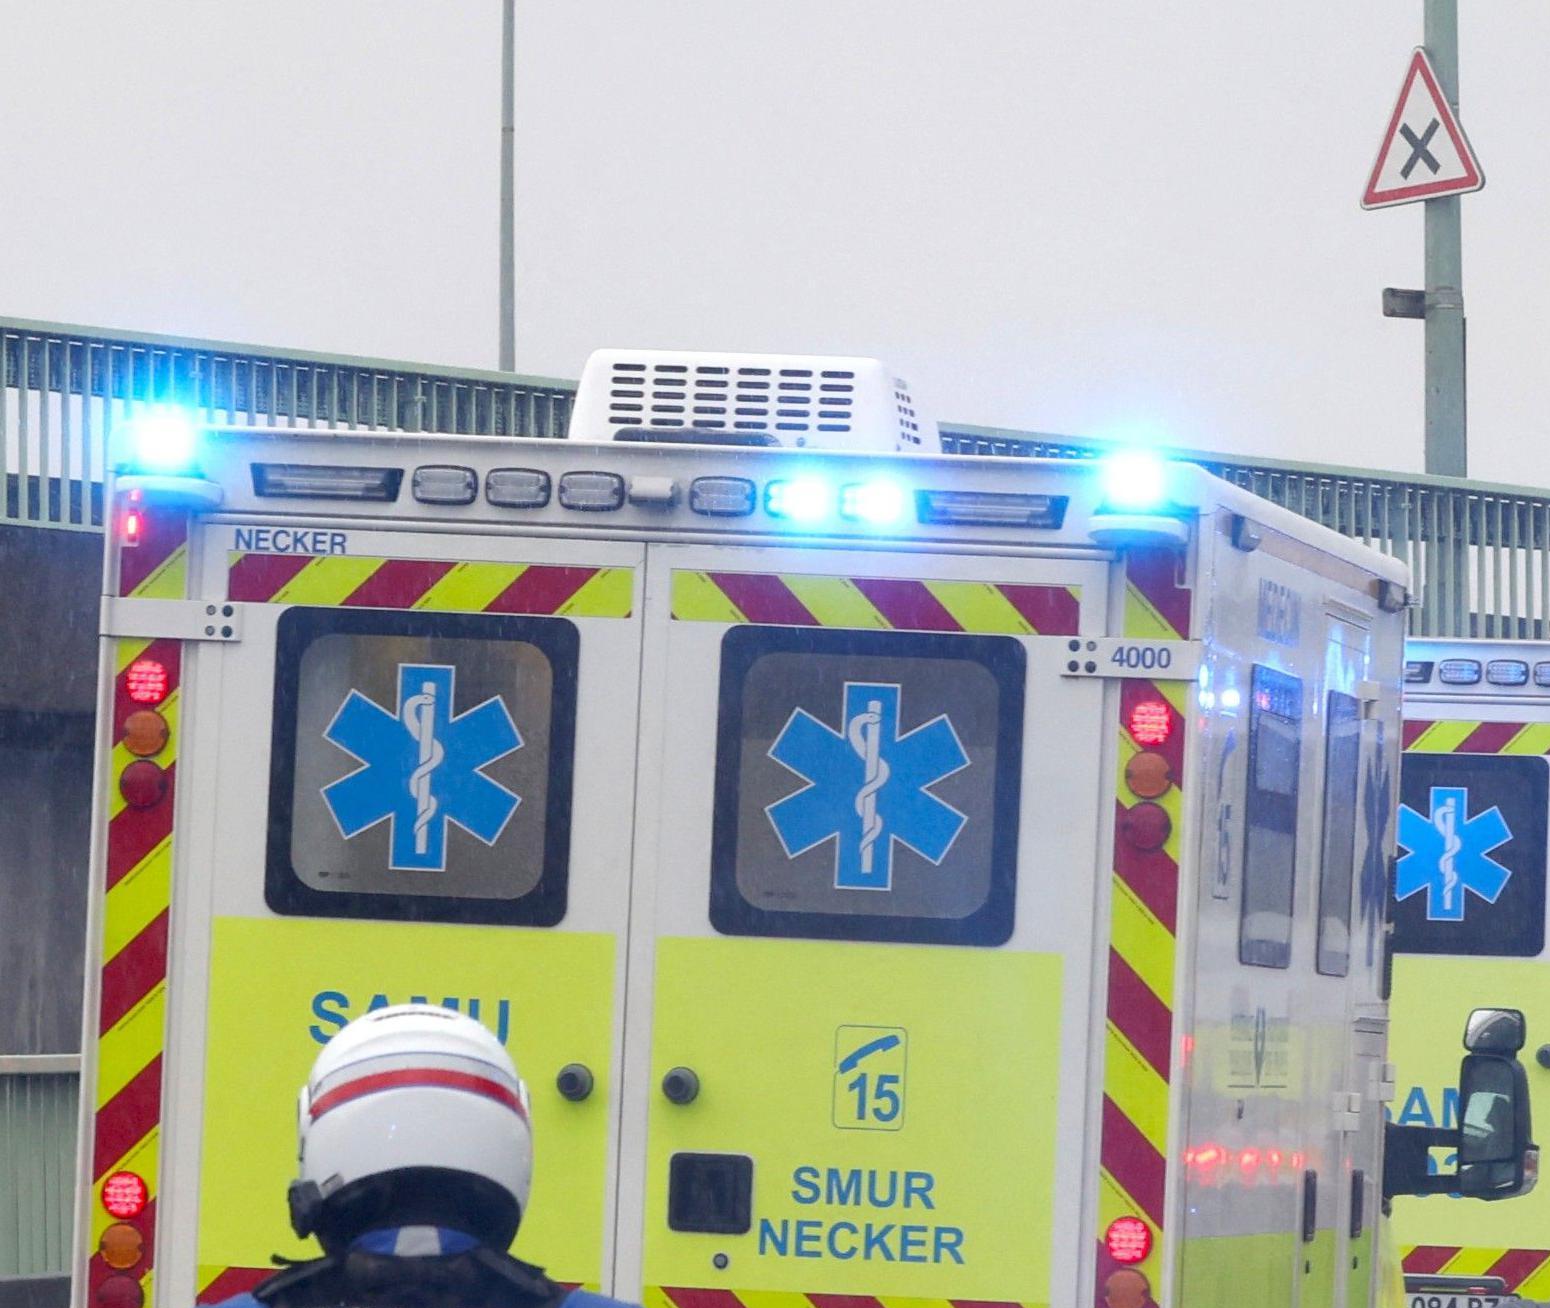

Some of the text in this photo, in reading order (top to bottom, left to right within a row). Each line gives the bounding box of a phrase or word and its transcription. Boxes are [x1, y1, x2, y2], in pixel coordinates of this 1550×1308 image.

[234, 527, 347, 555] NECKER
[1110, 645, 1171, 670] 4000
[847, 1072, 901, 1122] 15
[790, 1165, 936, 1210] SMUR
[758, 1217, 966, 1265] NECKER
